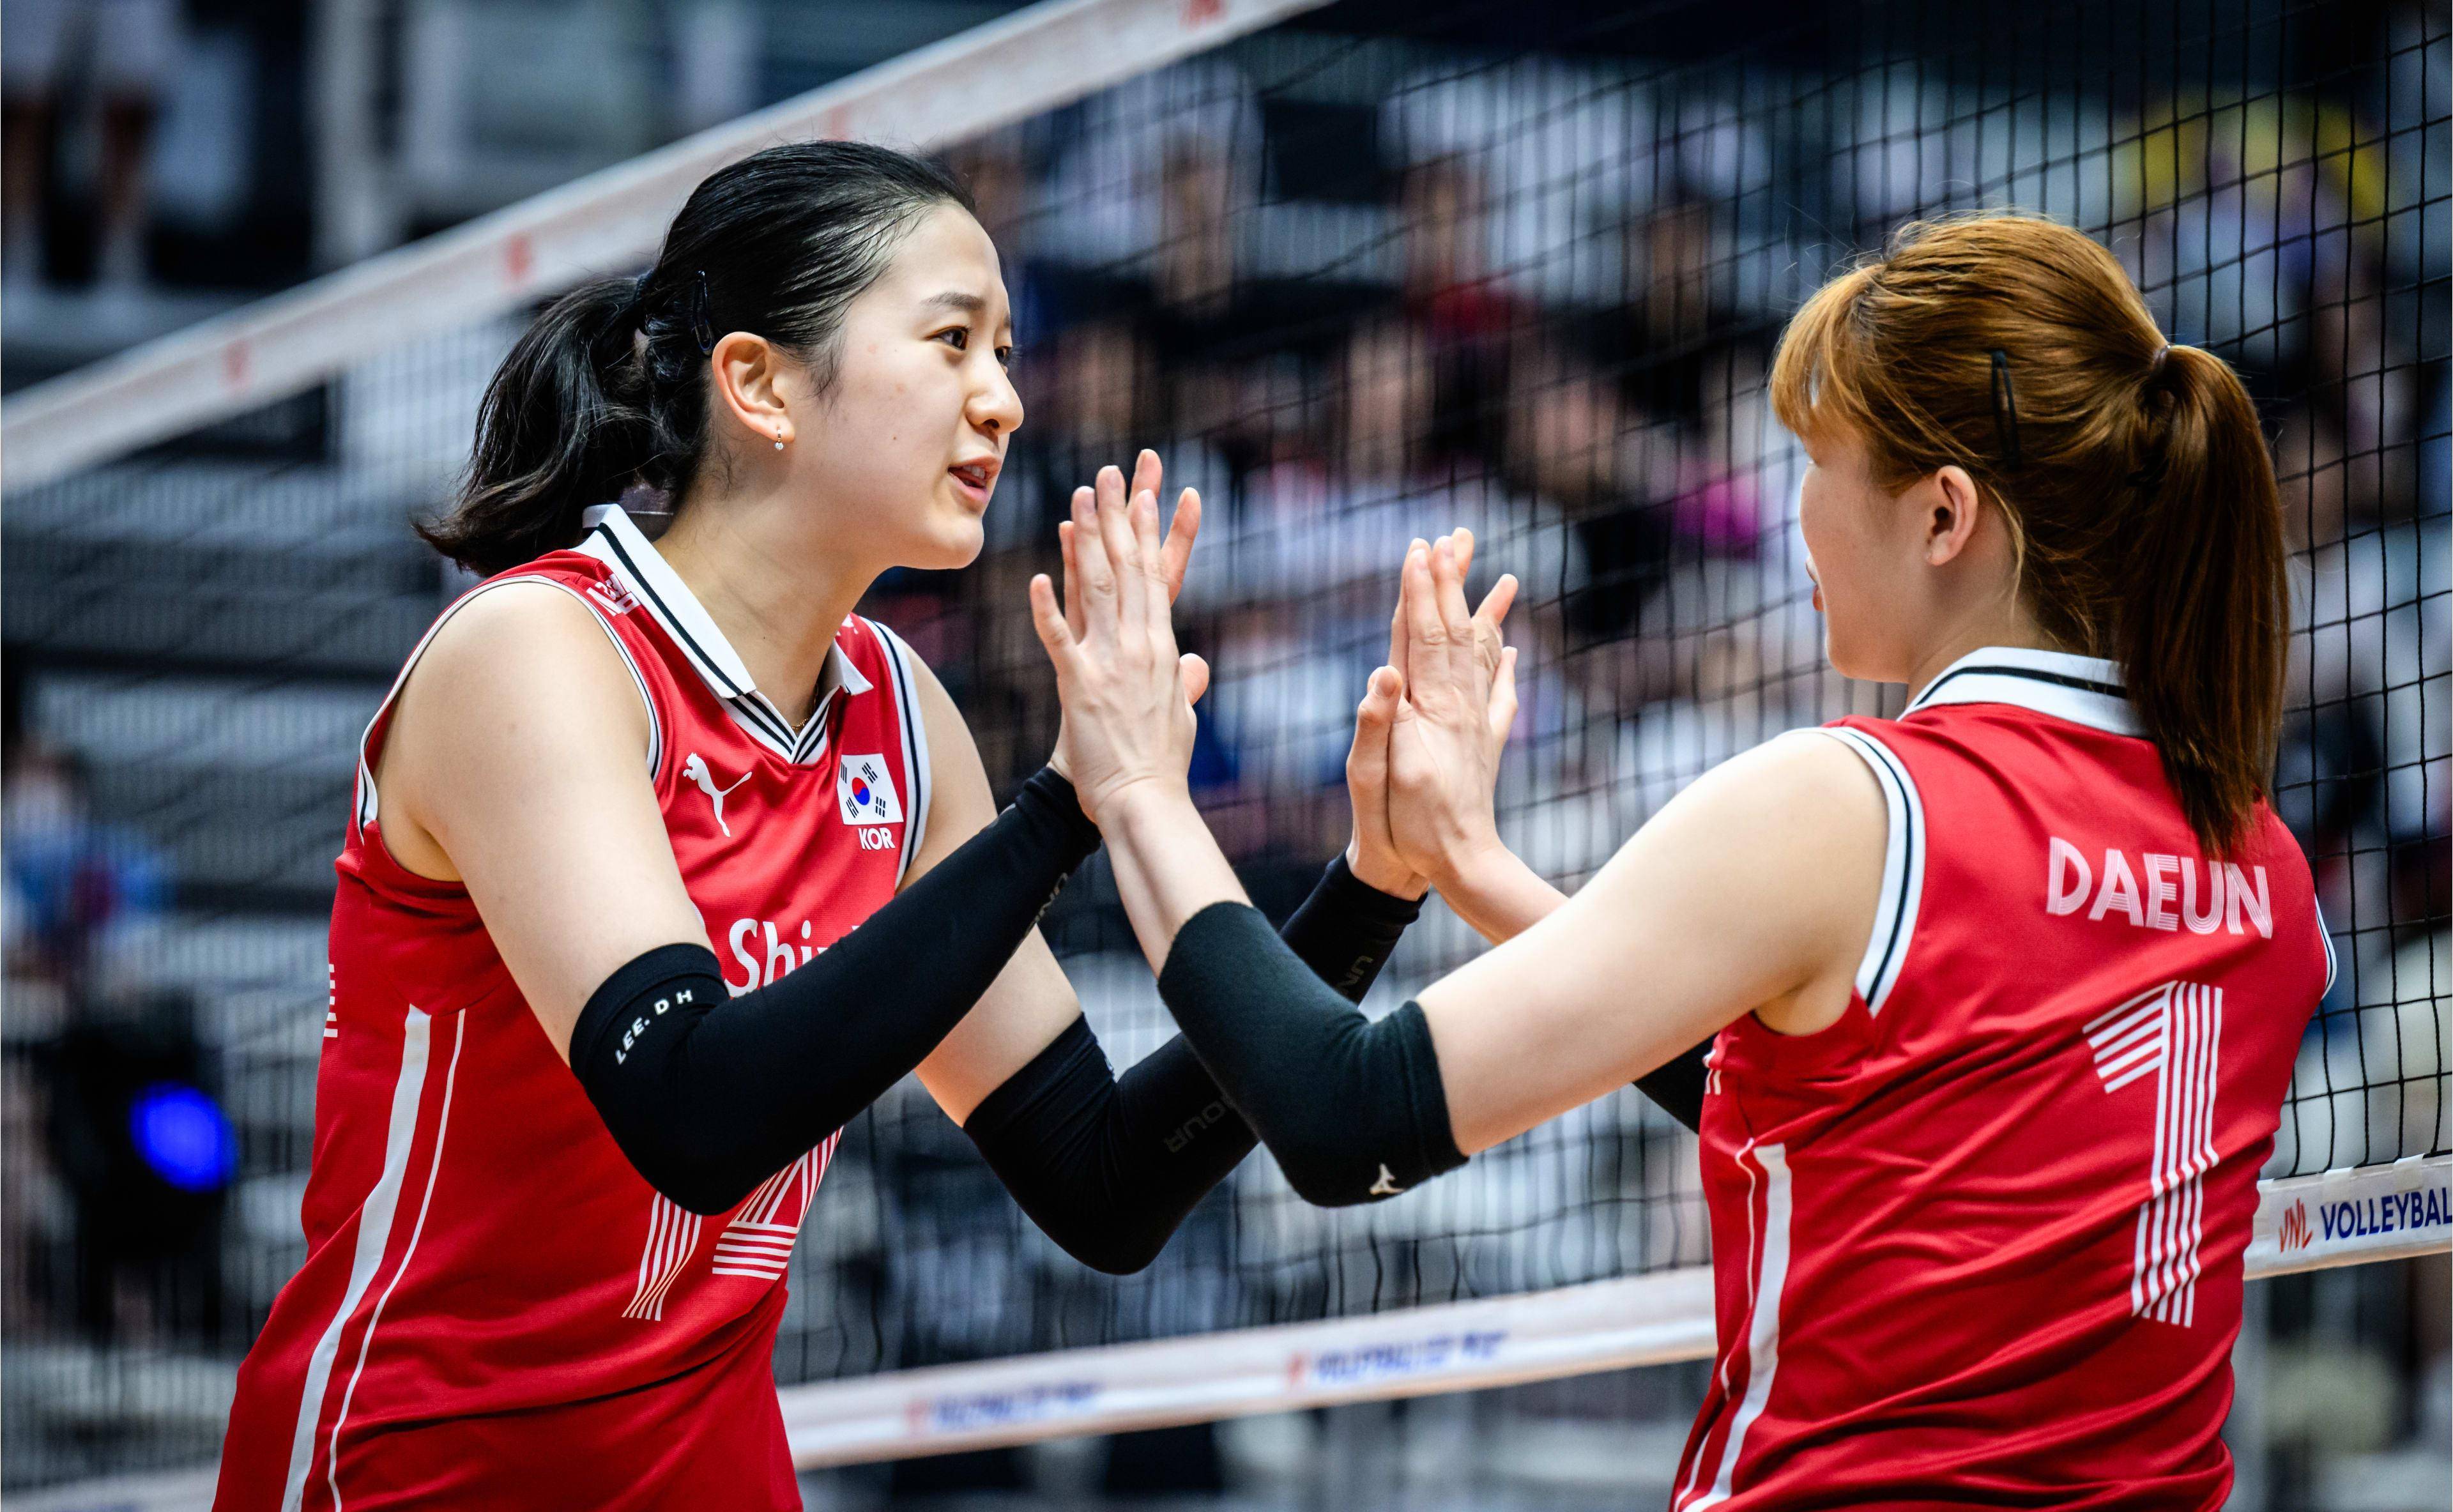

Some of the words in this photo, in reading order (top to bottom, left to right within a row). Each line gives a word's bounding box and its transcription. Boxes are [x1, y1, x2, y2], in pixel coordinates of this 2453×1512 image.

[858, 827, 896, 850] KOR
[2046, 836, 2273, 940] DAEUN
[724, 918, 860, 998] Shi
[2082, 980, 2222, 1328] 1
